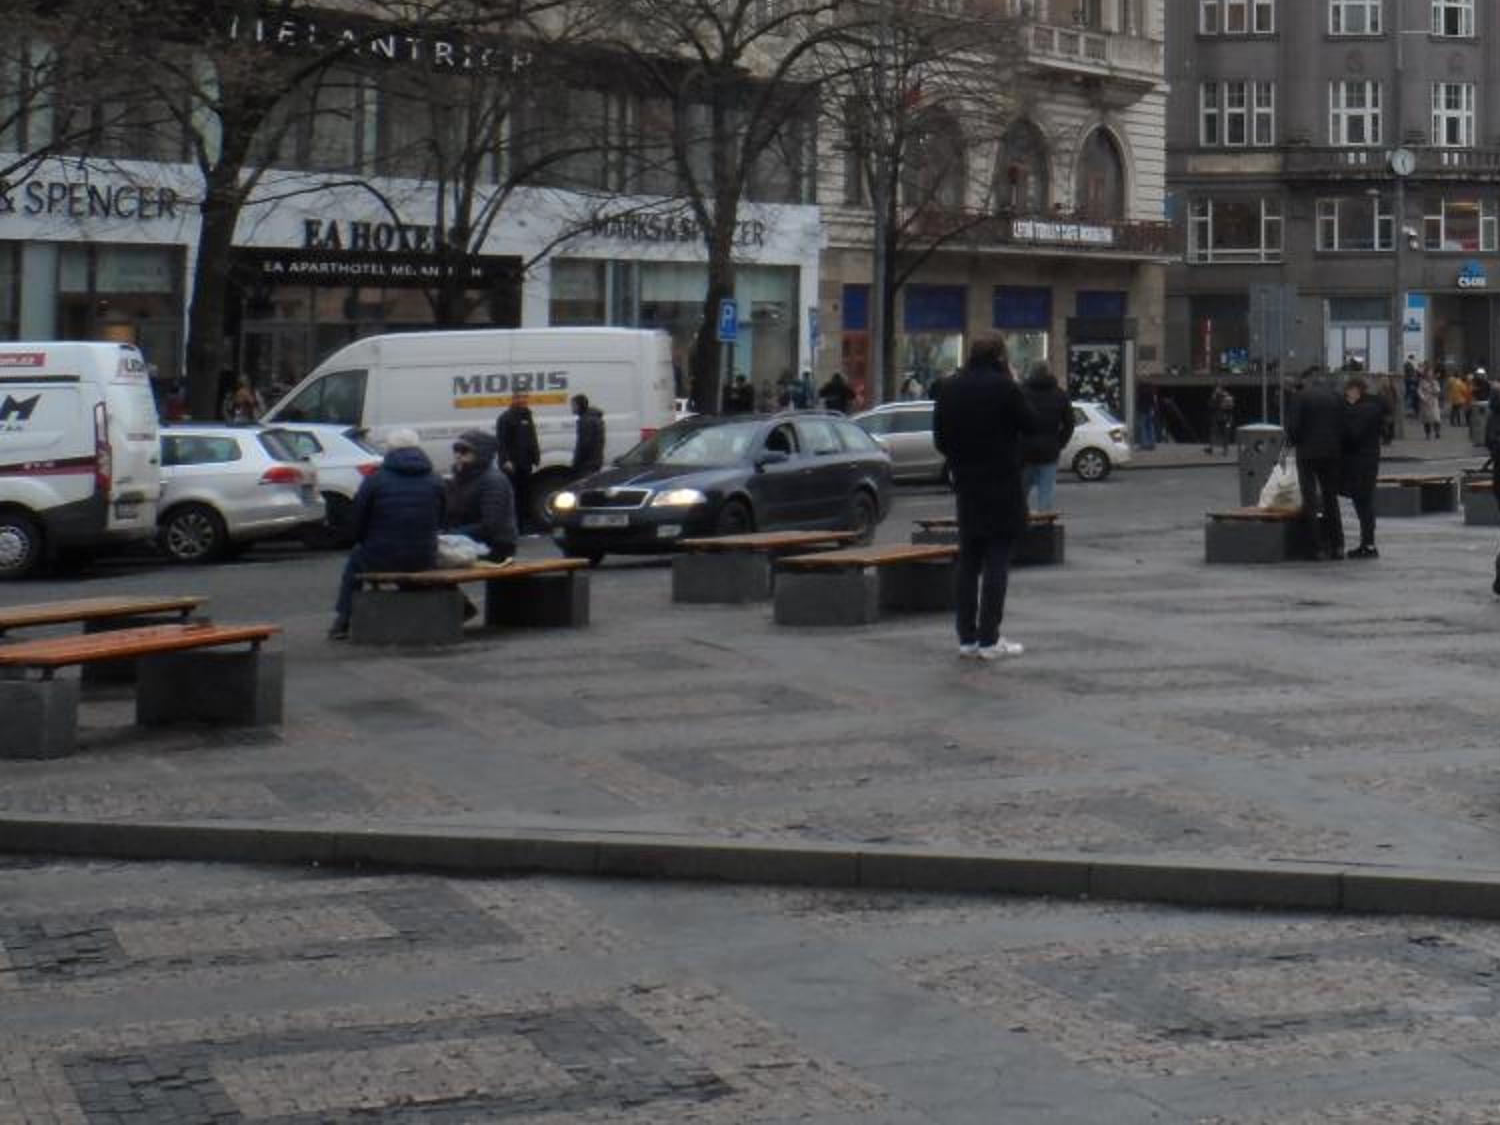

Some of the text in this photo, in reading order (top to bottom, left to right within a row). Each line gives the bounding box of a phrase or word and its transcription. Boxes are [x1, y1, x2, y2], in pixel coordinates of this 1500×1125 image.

[24, 180, 178, 219] SPENCER
[303, 219, 343, 252] EA
[288, 261, 385, 276] APARTHOTEL
[723, 304, 735, 330] P
